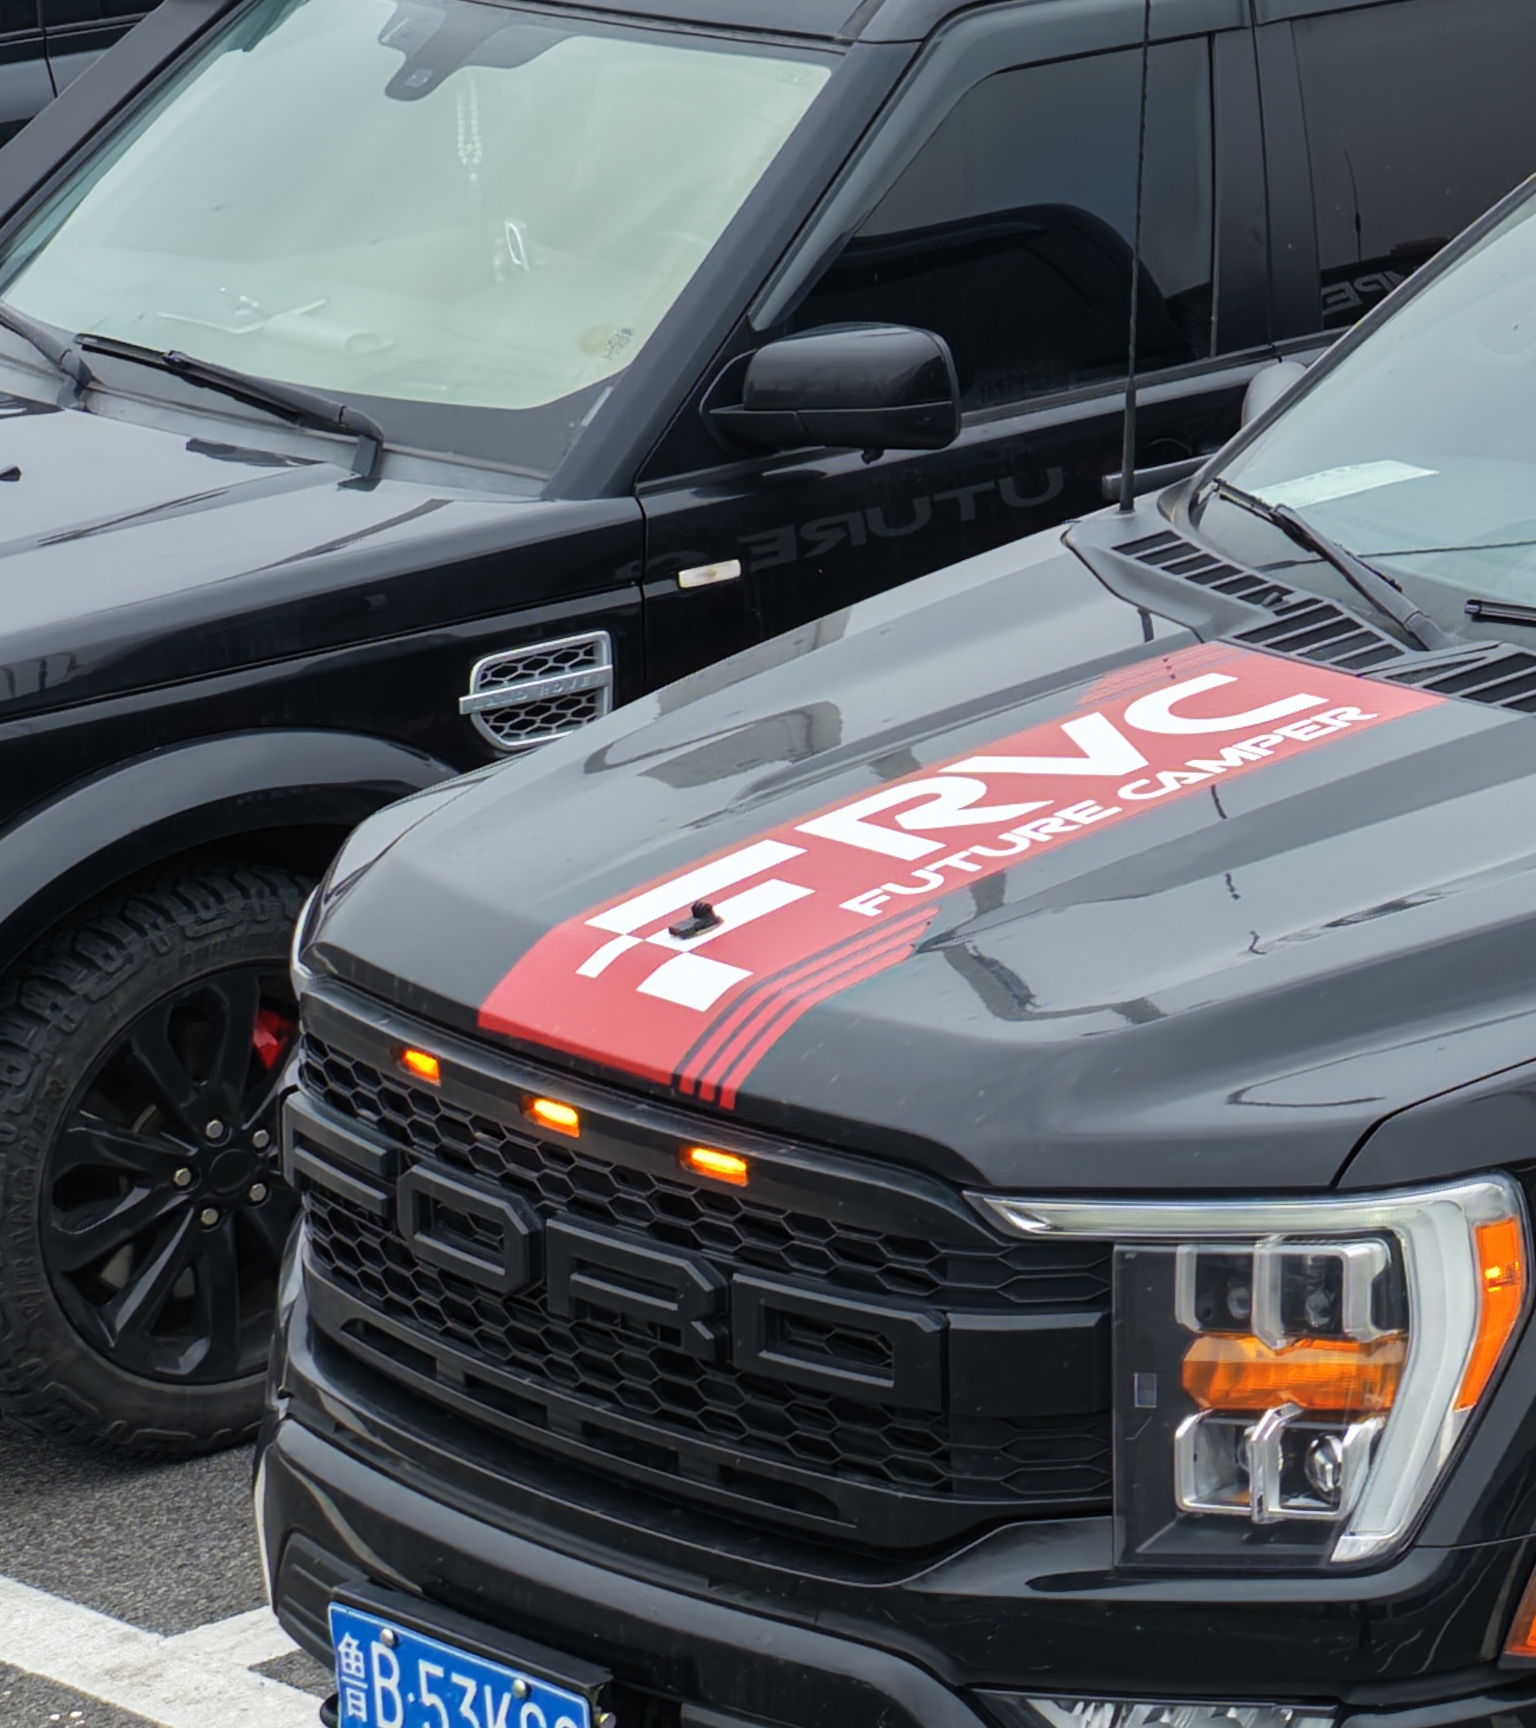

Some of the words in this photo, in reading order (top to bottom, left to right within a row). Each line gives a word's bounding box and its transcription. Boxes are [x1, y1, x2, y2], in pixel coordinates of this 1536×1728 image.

[838, 800, 1122, 917] FUTURE
[1117, 705, 1379, 801] CAMPER
[283, 1093, 948, 1412] FORD
[338, 1632, 578, 1728] 鲁B·53K
